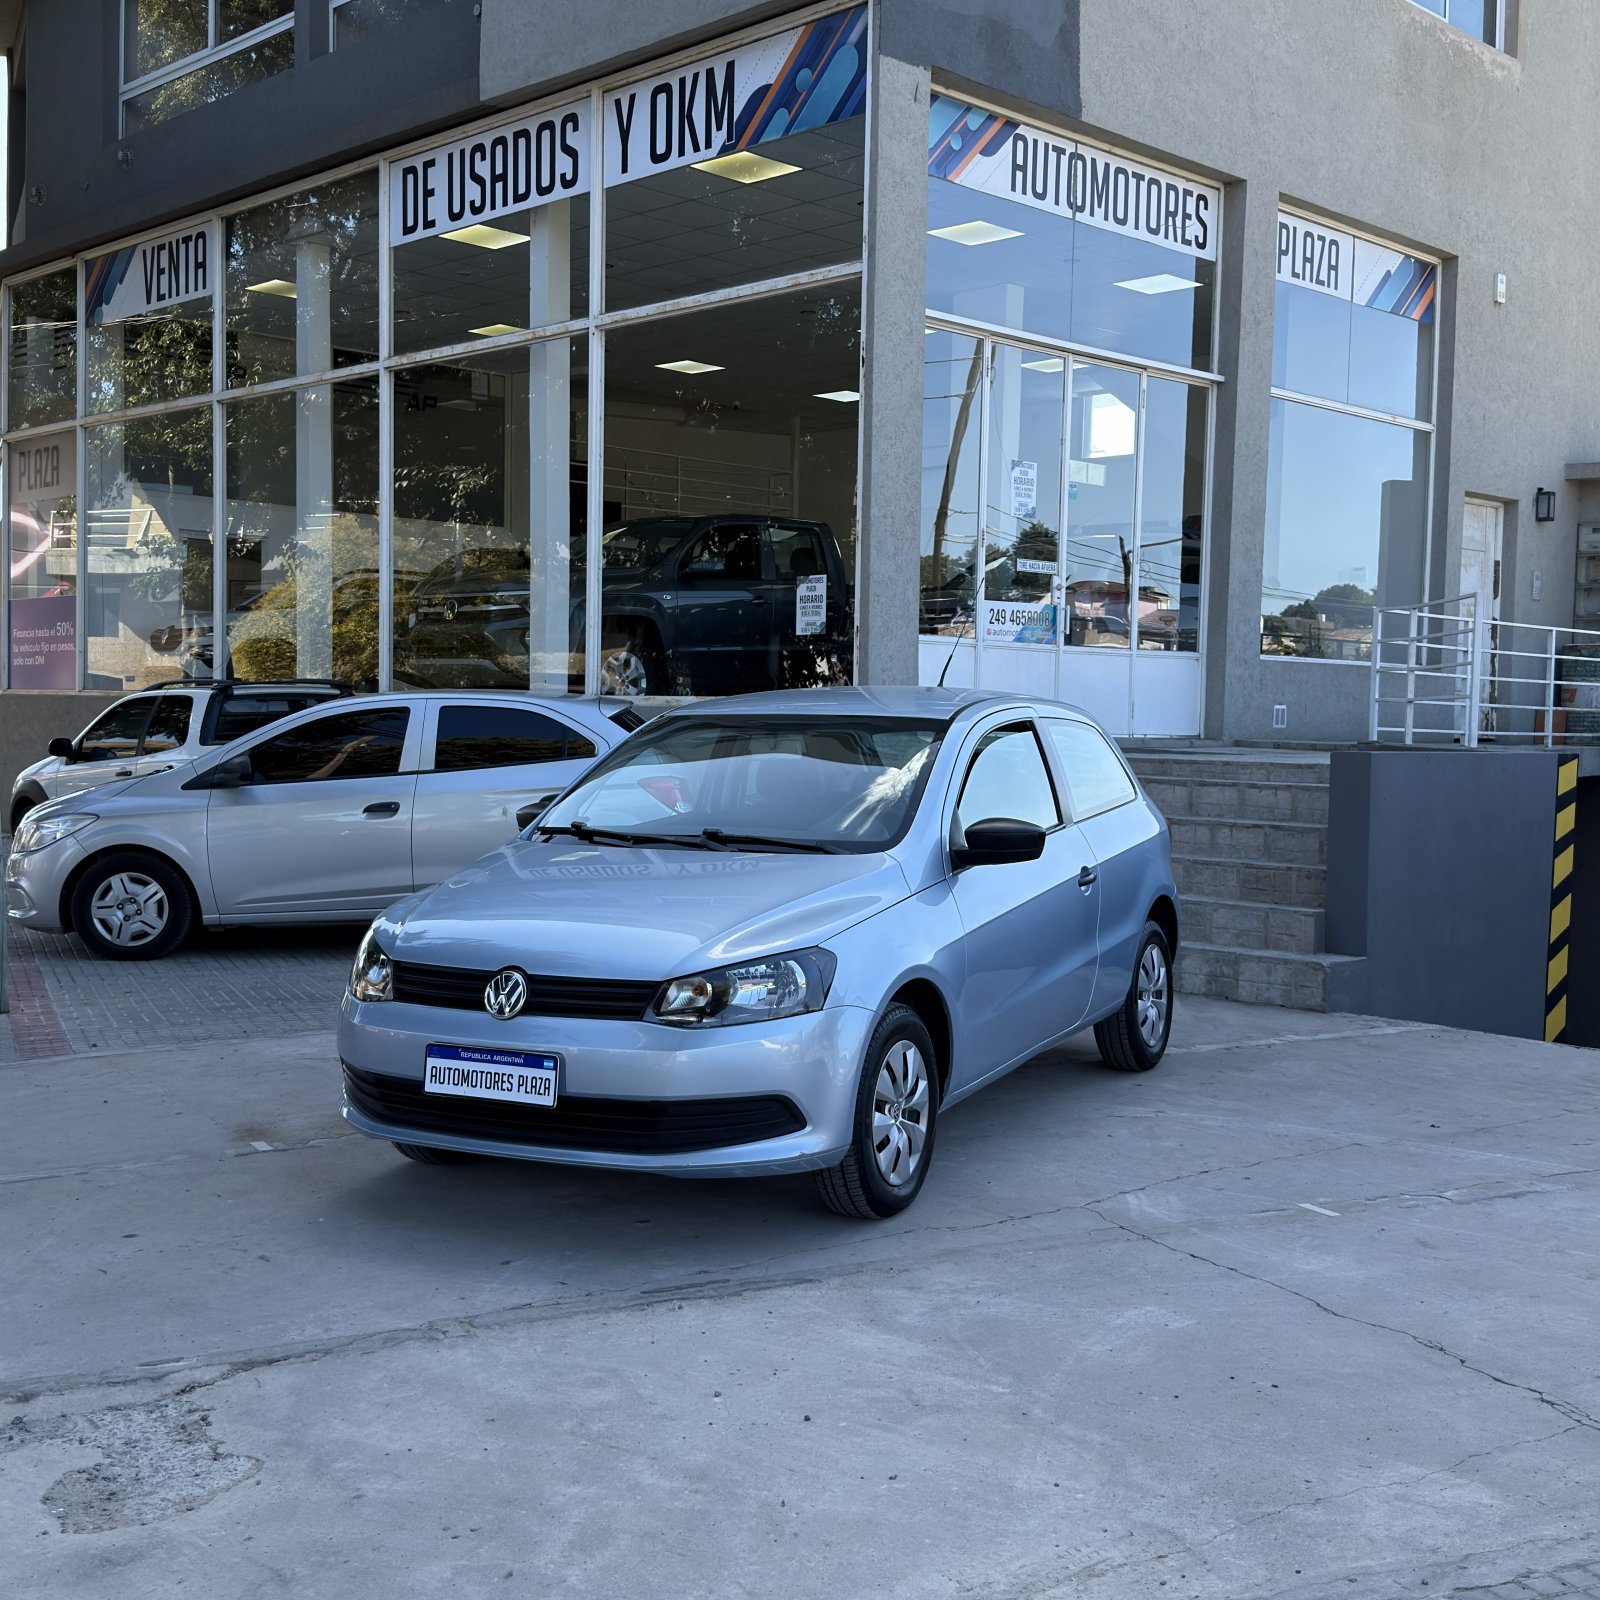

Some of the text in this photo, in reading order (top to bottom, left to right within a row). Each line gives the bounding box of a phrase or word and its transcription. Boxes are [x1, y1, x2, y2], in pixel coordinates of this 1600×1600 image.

[614, 93, 637, 175] Y
[402, 112, 580, 236] DE USADOS
[1010, 132, 1209, 250] AUTOMOTORES
[142, 231, 207, 305] VENTA
[1277, 222, 1340, 291] PLAZA
[18, 445, 60, 492] PLAZA
[1013, 476, 1035, 487] HORARIO
[1019, 561, 1028, 570] TIRE
[1041, 562, 1056, 571] AFUERA
[800, 595, 824, 604] HORARIO
[13, 621, 74, 638] Financia hasta el 50%
[988, 608, 1050, 627] 249 4658008
[35, 656, 45, 665] DNI
[460, 1051, 524, 1064] REPUBLICA ARGENTINA
[430, 1065, 551, 1097] AUTOMOTORES PLAZA
